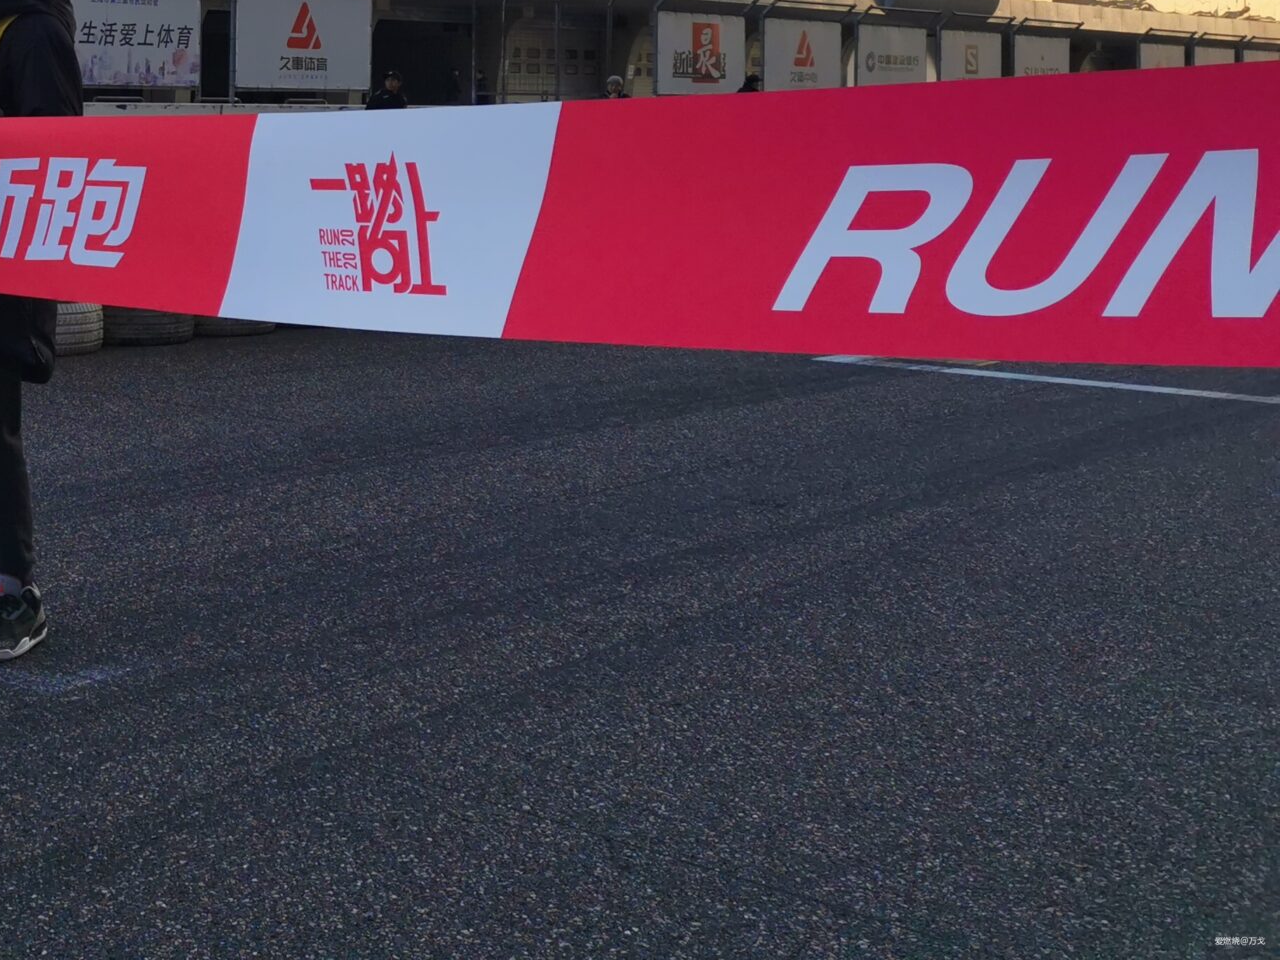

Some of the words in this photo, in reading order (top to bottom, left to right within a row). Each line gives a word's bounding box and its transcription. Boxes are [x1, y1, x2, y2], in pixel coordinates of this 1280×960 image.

[78, 20, 194, 49] 生活爱上体育
[280, 55, 328, 71] 久事体育
[319, 228, 341, 246] RUN
[771, 148, 1280, 318] RUN
[321, 251, 343, 269] THE
[324, 273, 360, 292] TRACK
